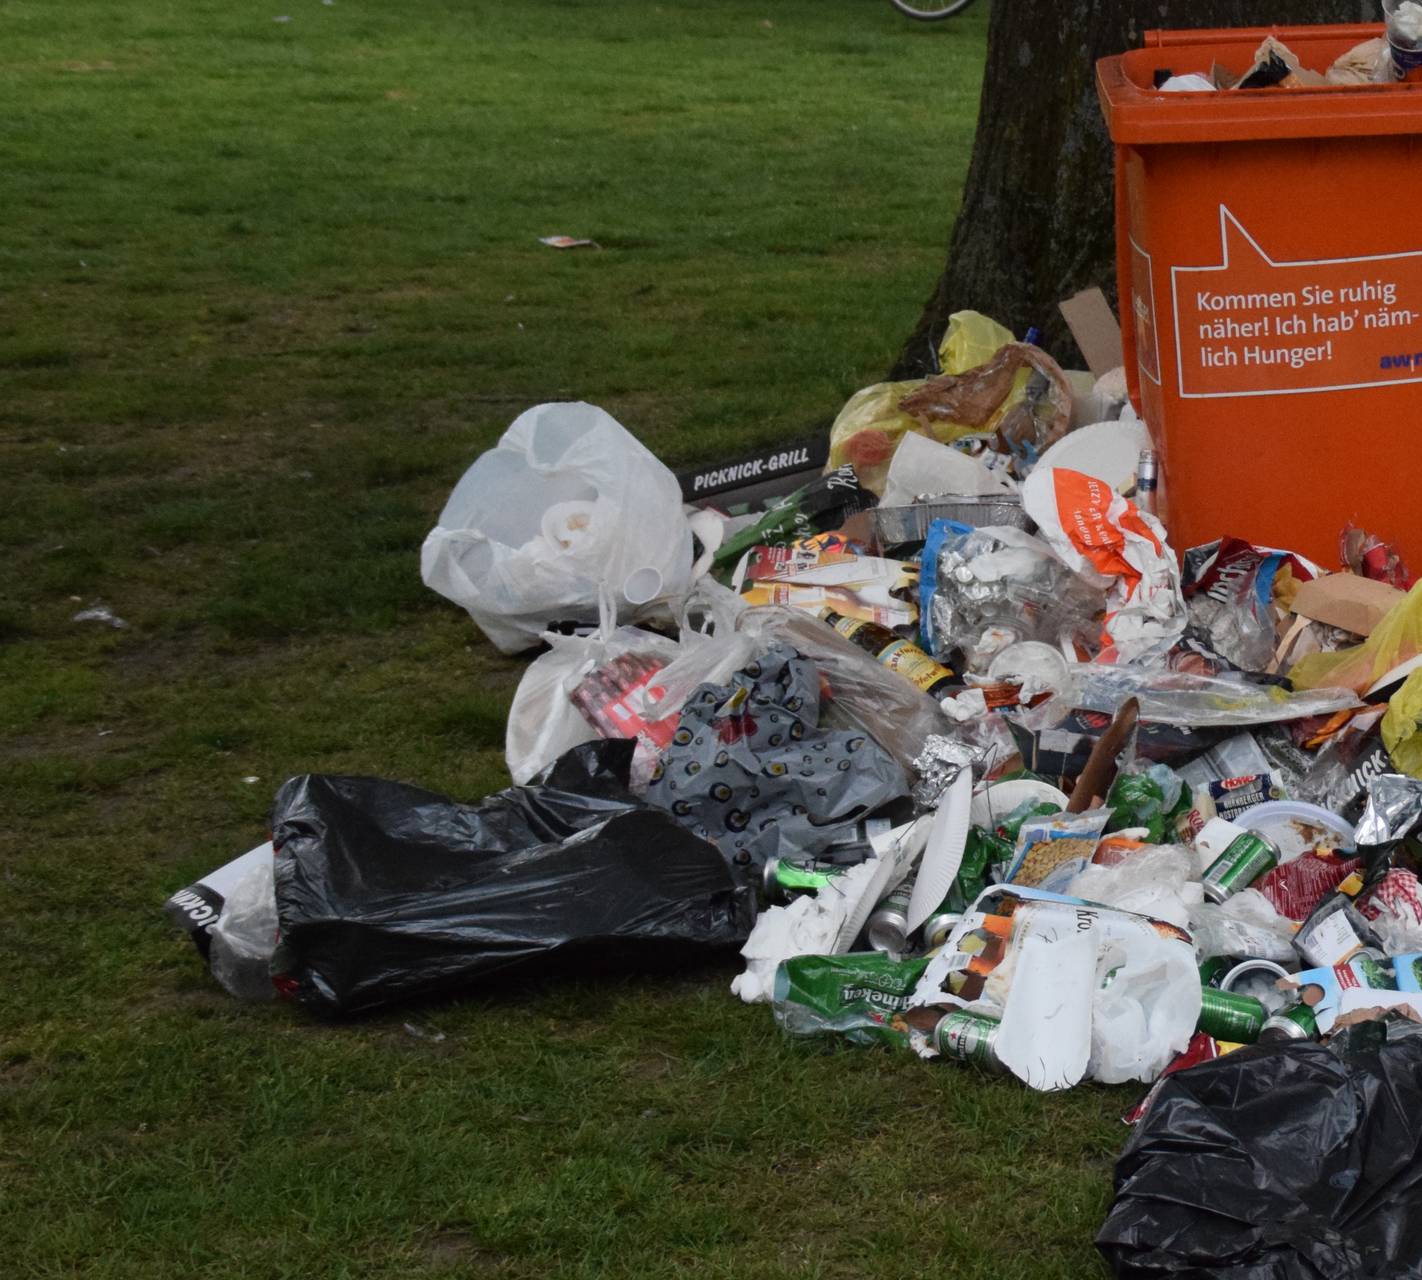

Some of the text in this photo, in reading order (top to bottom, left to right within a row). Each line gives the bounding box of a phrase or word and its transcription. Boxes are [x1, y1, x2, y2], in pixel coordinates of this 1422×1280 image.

[1197, 281, 1397, 312] Kommen Sie ruhig
[1199, 314, 1270, 339] näher!
[1276, 315, 1308, 336] Ich
[1364, 307, 1420, 329] näm-
[1200, 342, 1333, 370] lich Hunger!
[693, 447, 811, 492] PICKNICK-GRILL
